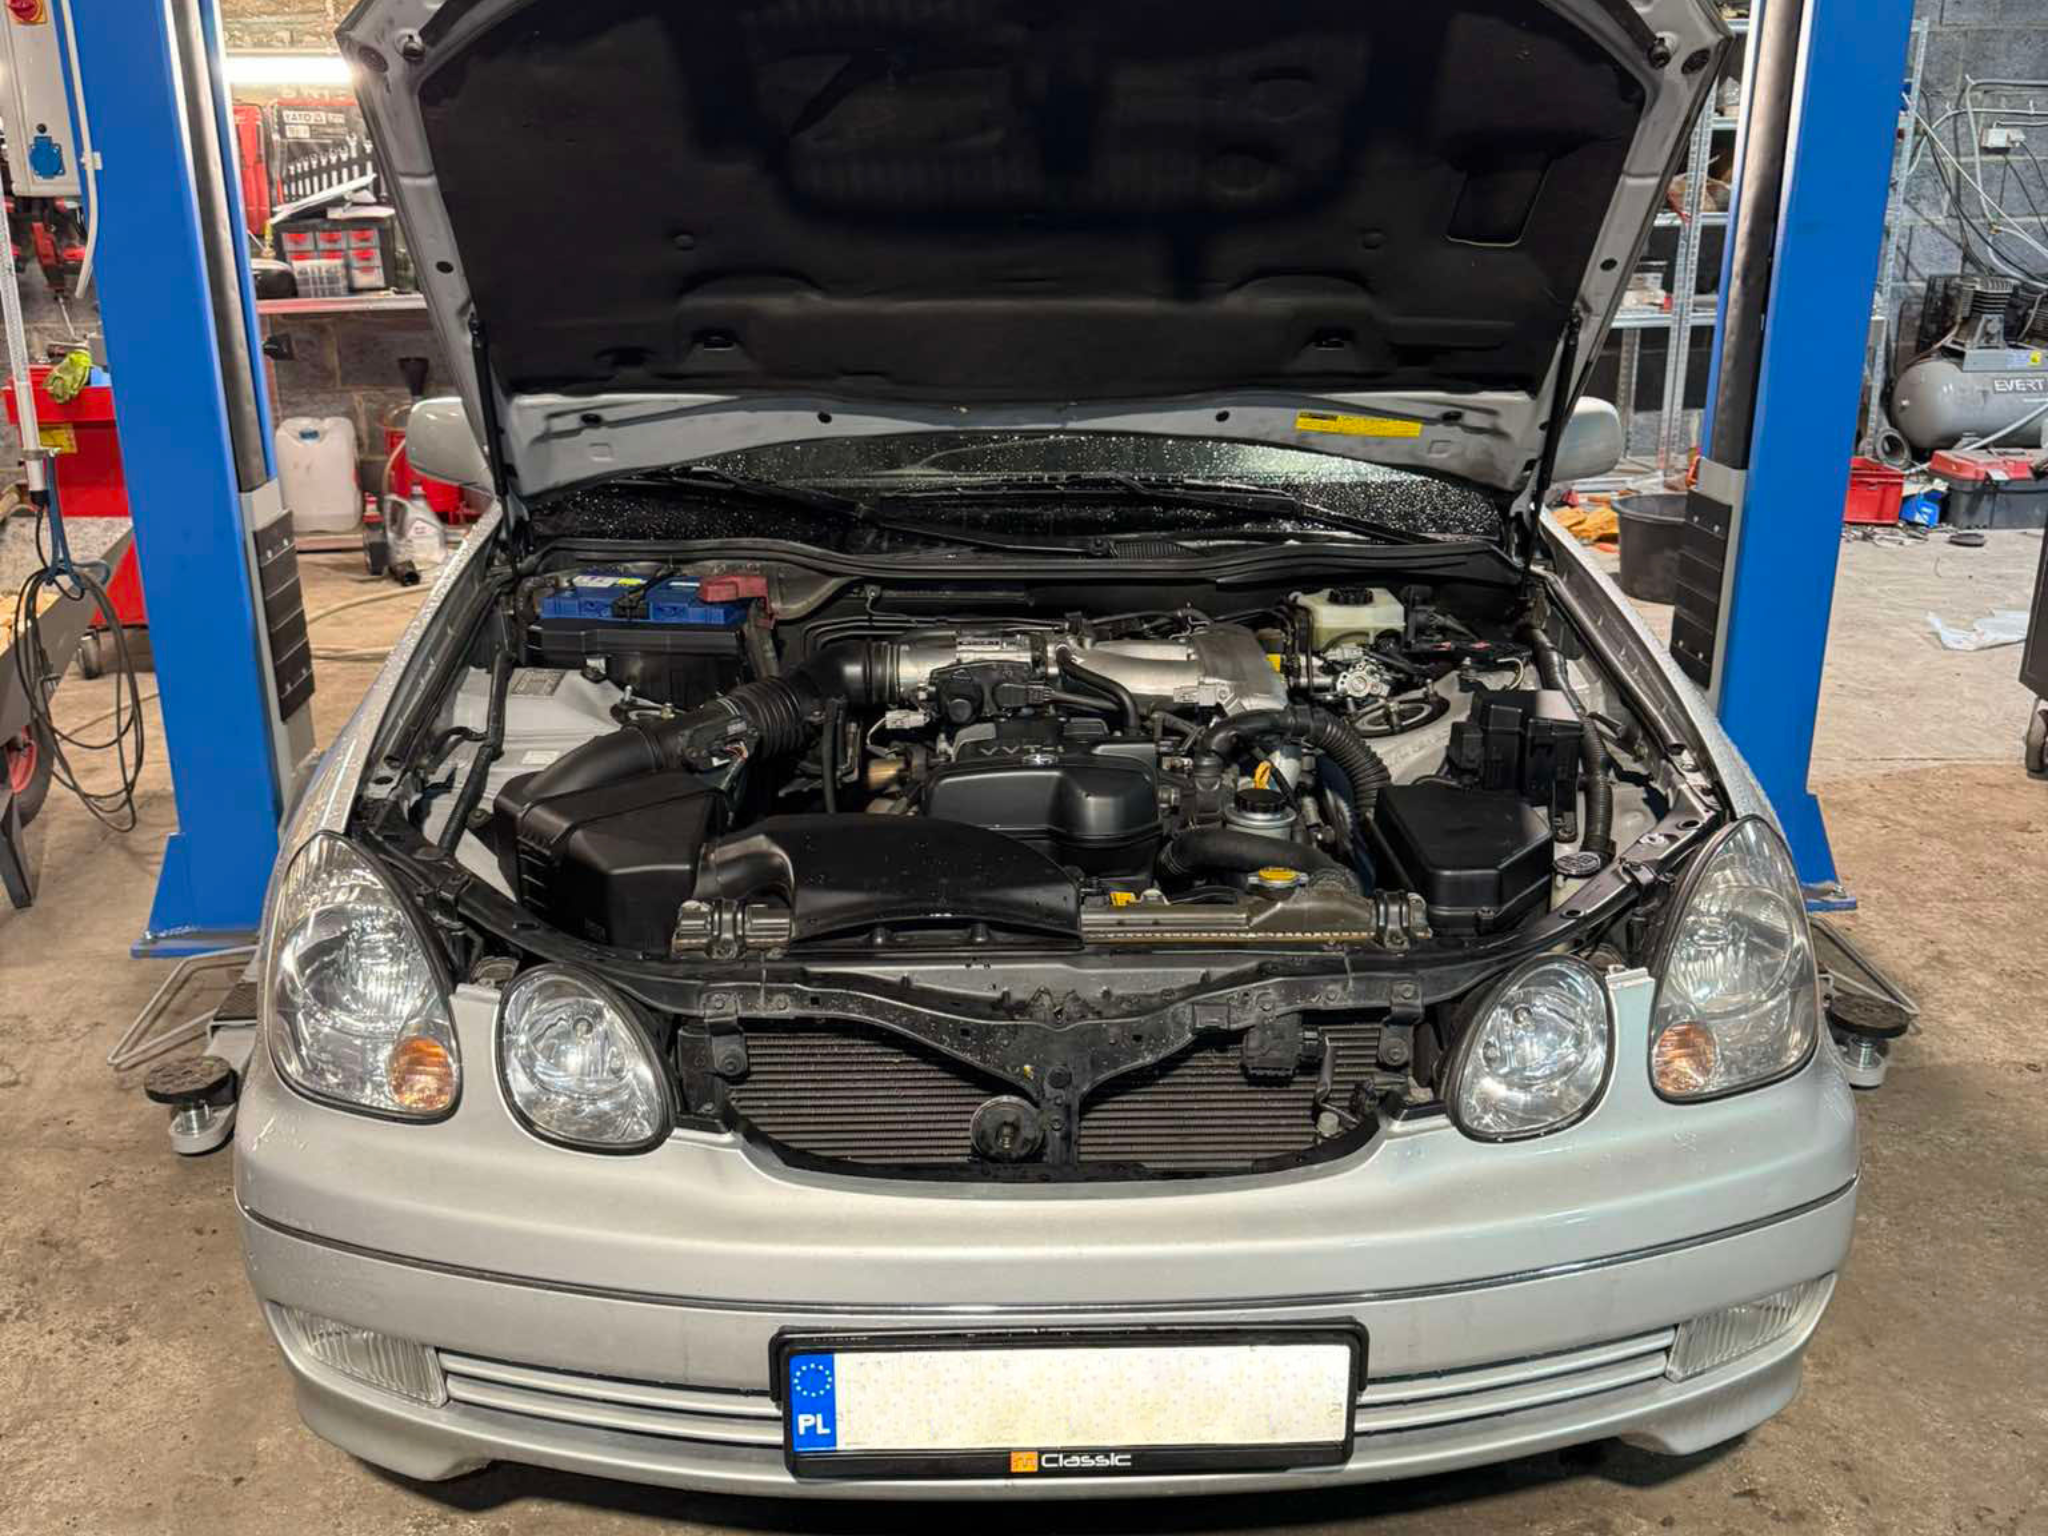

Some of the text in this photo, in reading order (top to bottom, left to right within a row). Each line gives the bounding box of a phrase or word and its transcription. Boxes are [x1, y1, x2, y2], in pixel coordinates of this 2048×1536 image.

[284, 113, 312, 122] YATO
[1994, 378, 2045, 391] EVERT
[798, 1413, 831, 1435] PL
[1041, 1452, 1131, 1468] Classic
